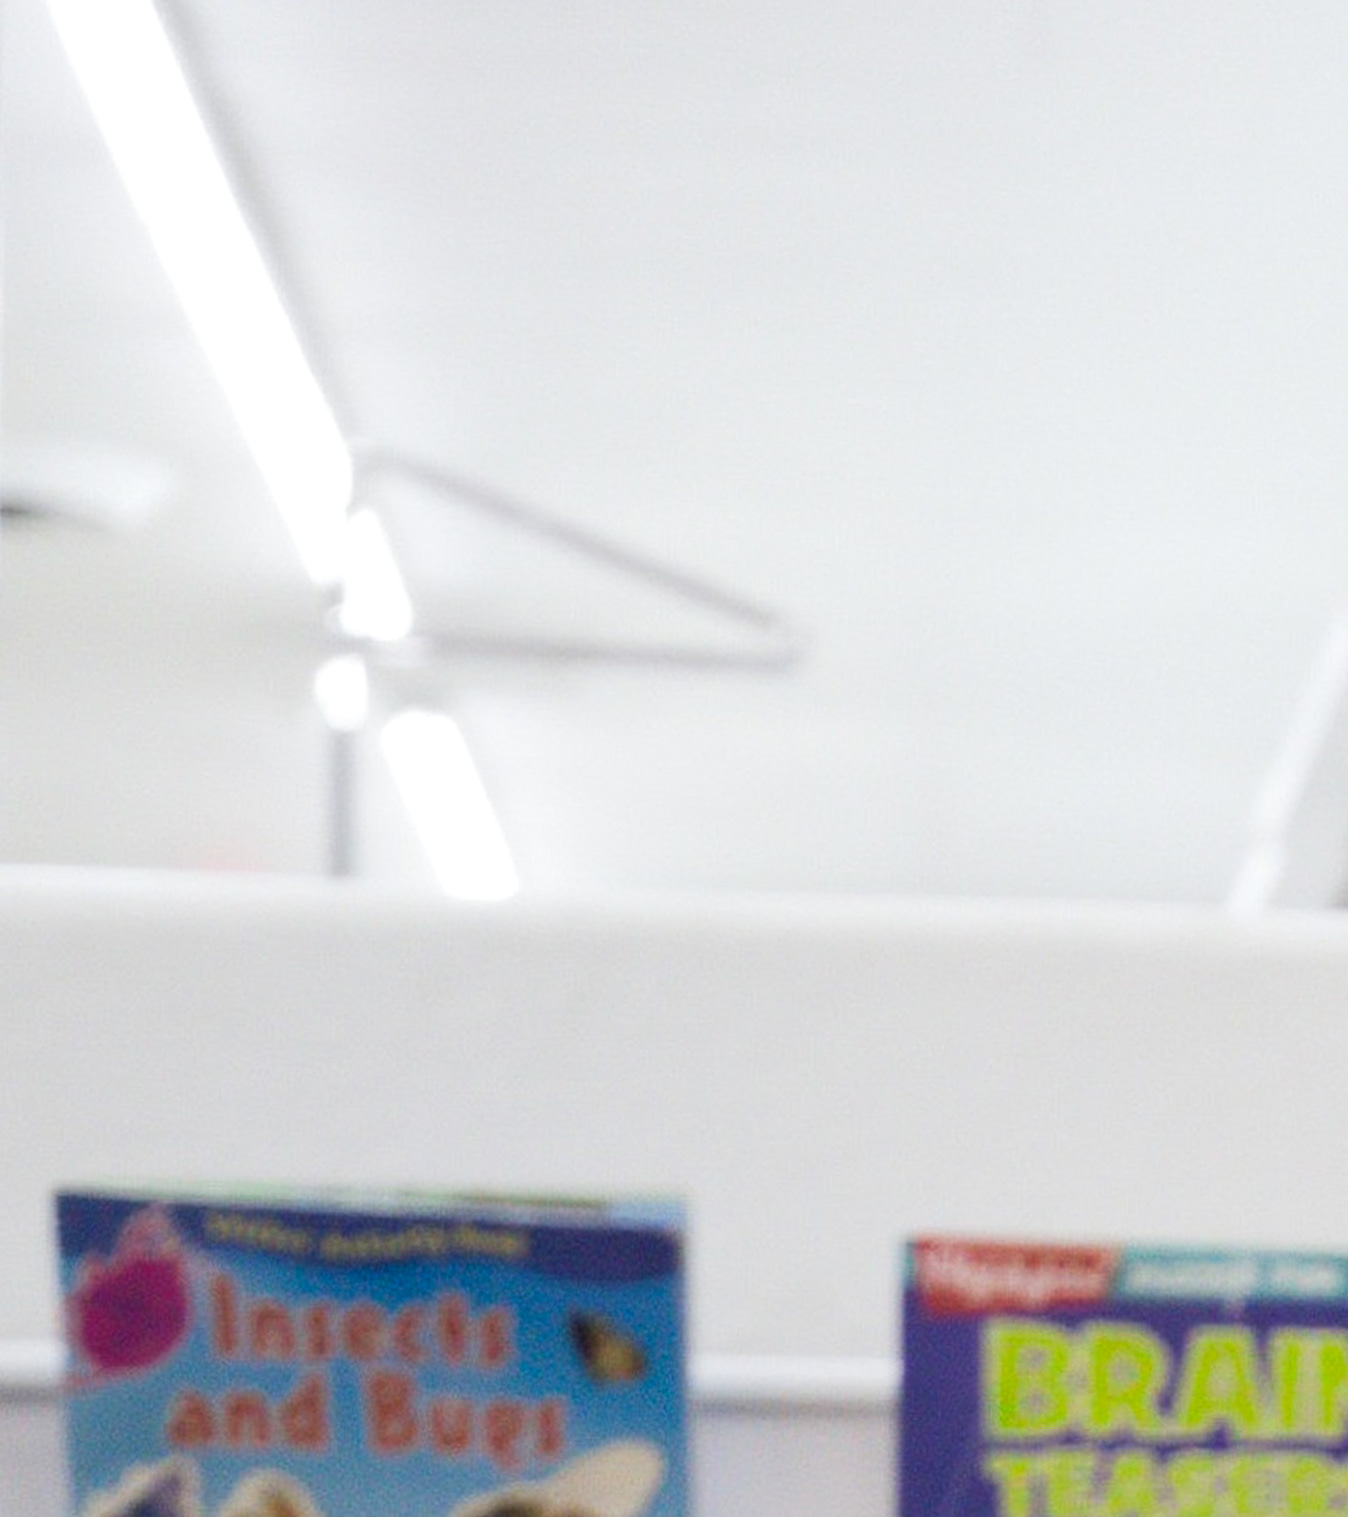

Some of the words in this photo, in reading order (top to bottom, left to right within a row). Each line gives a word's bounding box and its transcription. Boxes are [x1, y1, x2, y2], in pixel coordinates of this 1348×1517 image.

[210, 1275, 512, 1366] Insects
[168, 1375, 328, 1450] and
[365, 1370, 566, 1468] Bugs
